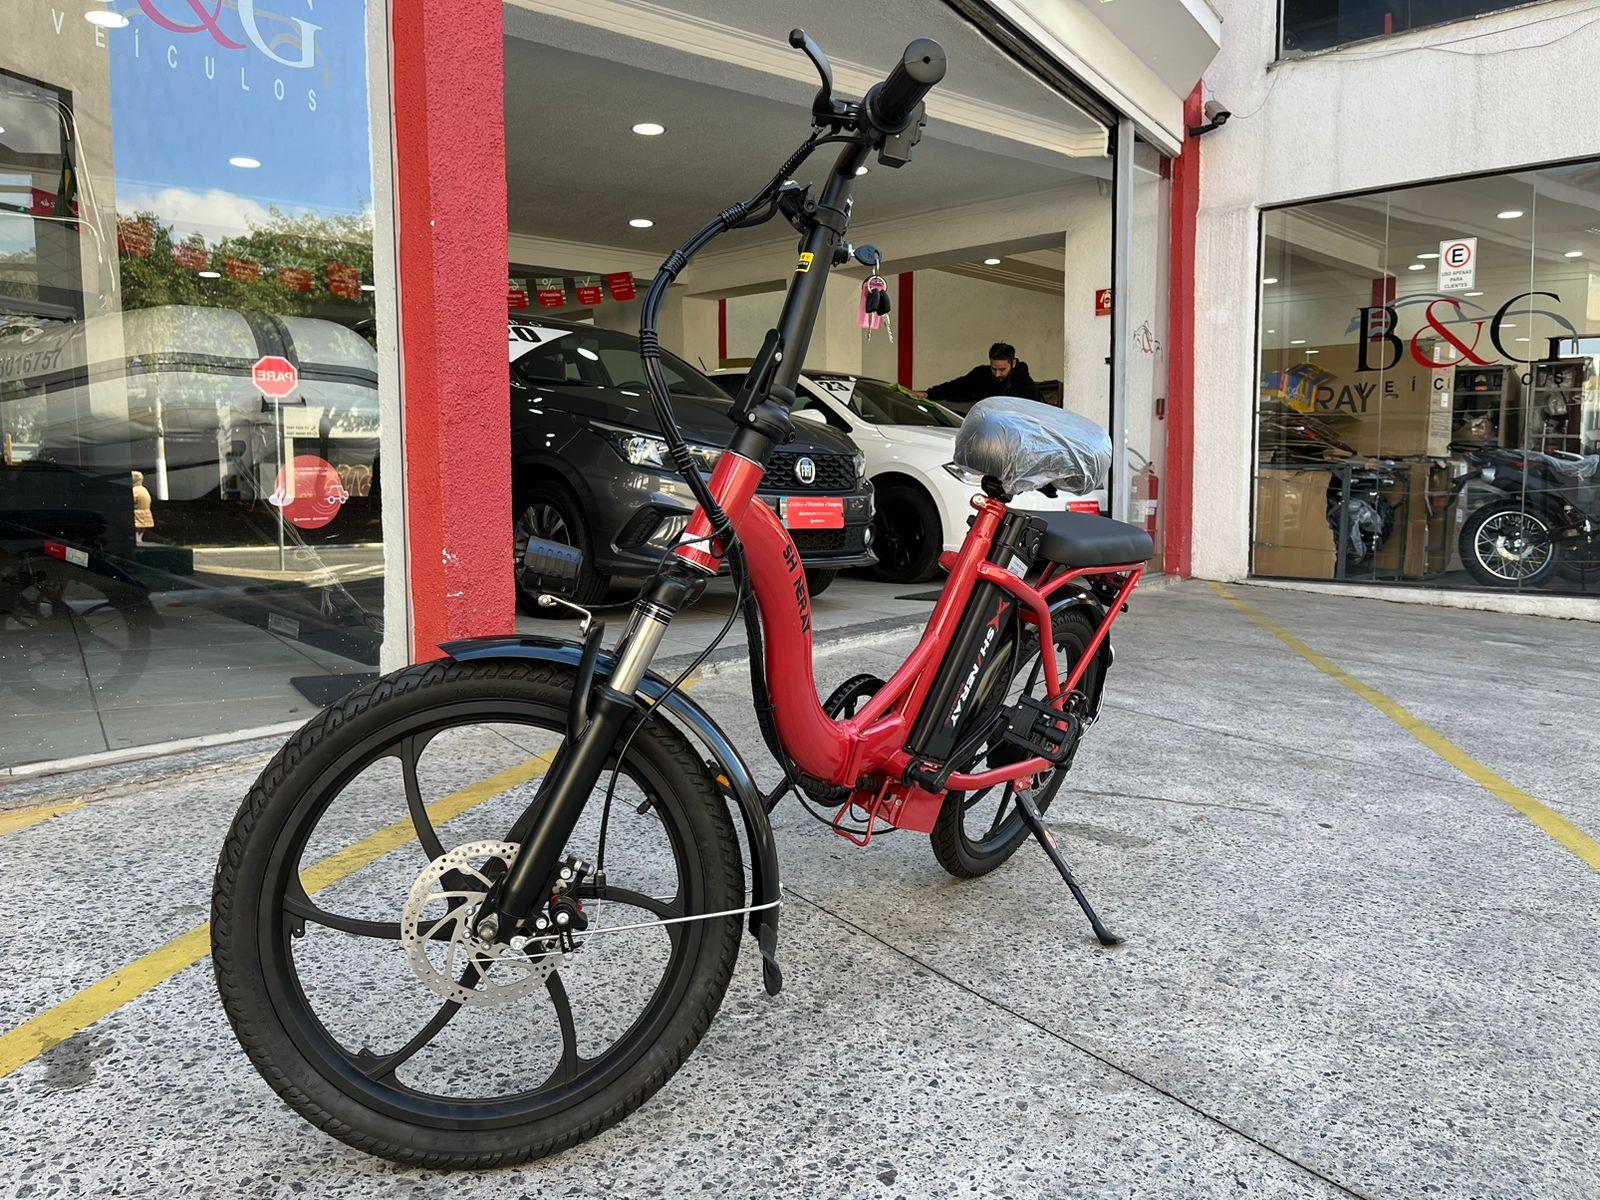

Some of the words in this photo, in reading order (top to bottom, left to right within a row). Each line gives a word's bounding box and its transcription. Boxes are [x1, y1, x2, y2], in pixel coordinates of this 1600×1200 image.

[1452, 248, 1464, 263] E
[508, 326, 542, 343] 0
[1355, 291, 1561, 372] B&G
